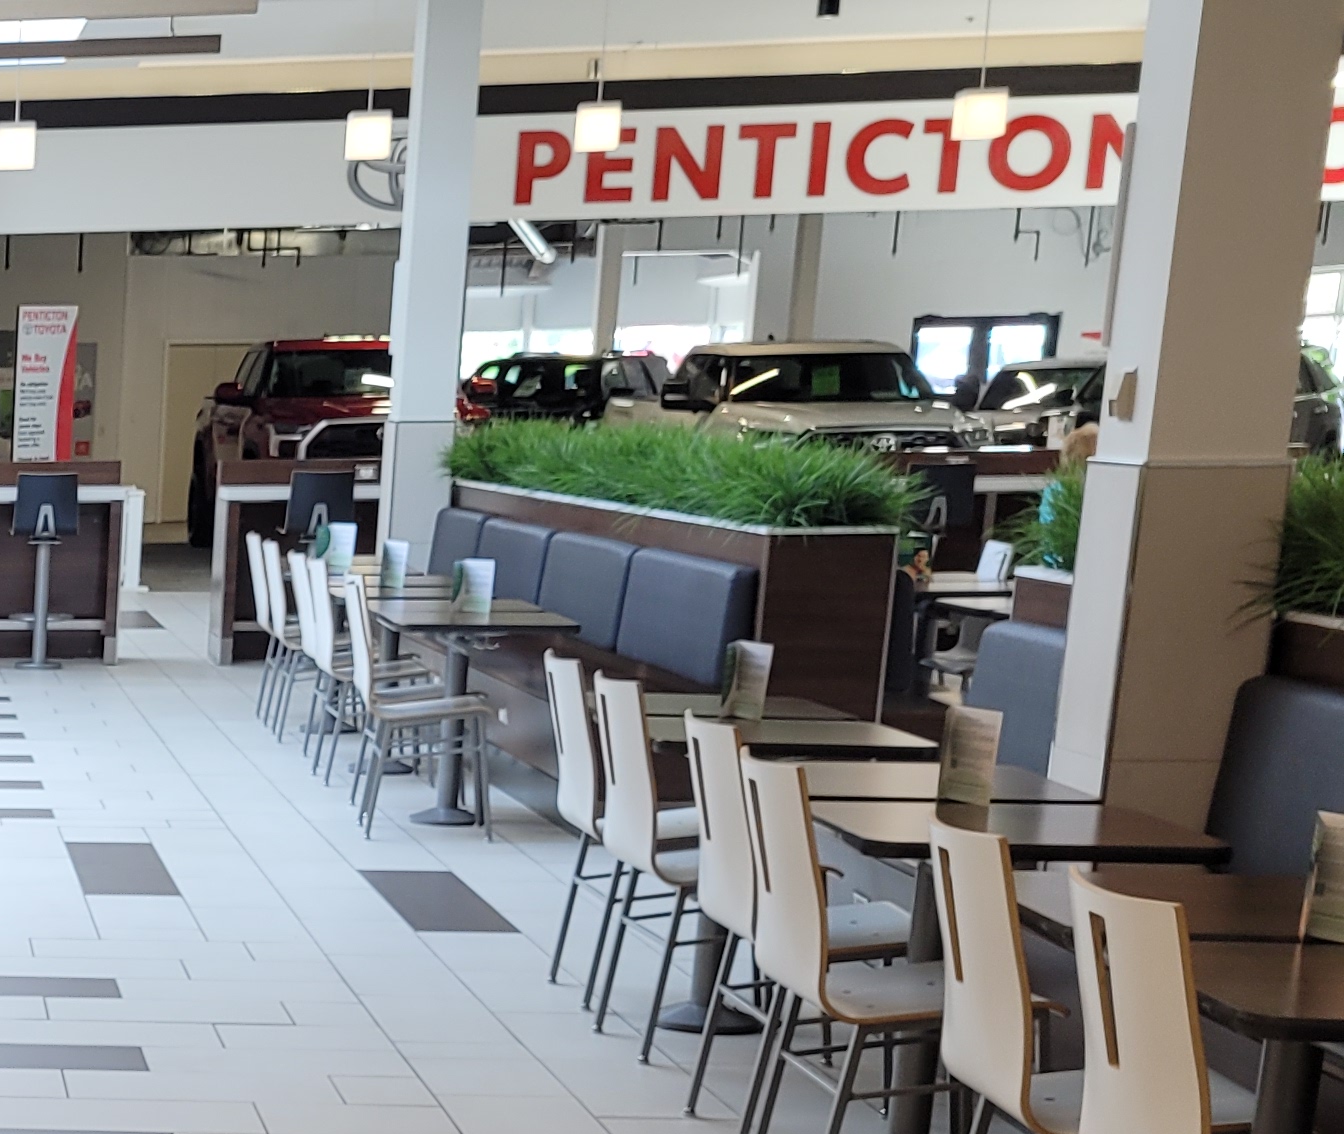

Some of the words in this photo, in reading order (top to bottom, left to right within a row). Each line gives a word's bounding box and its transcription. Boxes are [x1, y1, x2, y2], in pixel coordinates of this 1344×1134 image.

[514, 114, 1125, 205] PENTICTON
[22, 311, 69, 321] PENTICTON
[34, 325, 67, 335] TOYOTA
